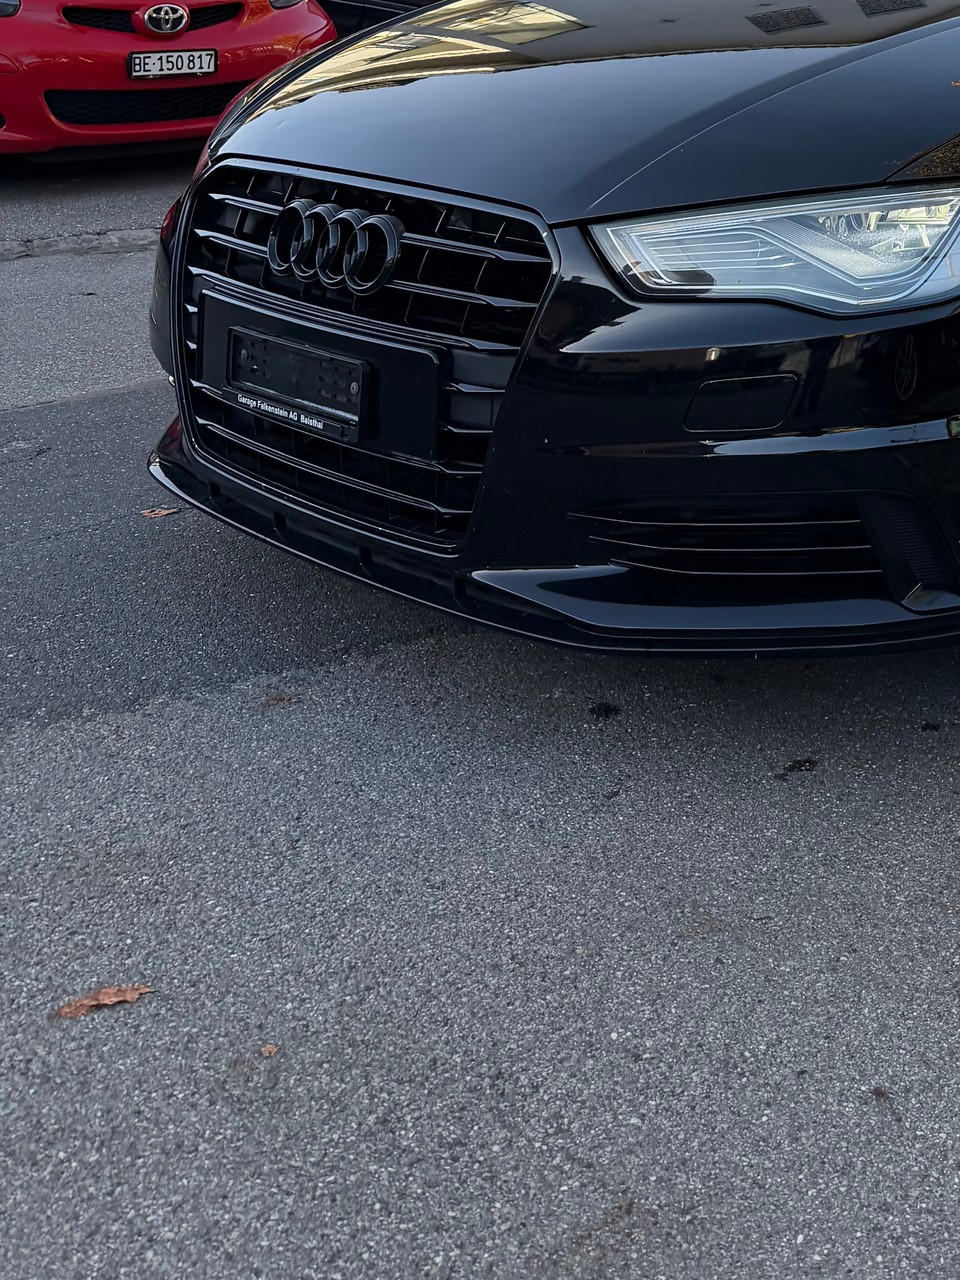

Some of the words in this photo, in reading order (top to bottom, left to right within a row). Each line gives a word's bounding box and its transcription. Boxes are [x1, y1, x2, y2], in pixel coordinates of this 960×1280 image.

[237, 394, 257, 407] Garage
[257, 400, 288, 418] Falkenstein
[289, 411, 298, 421] AG
